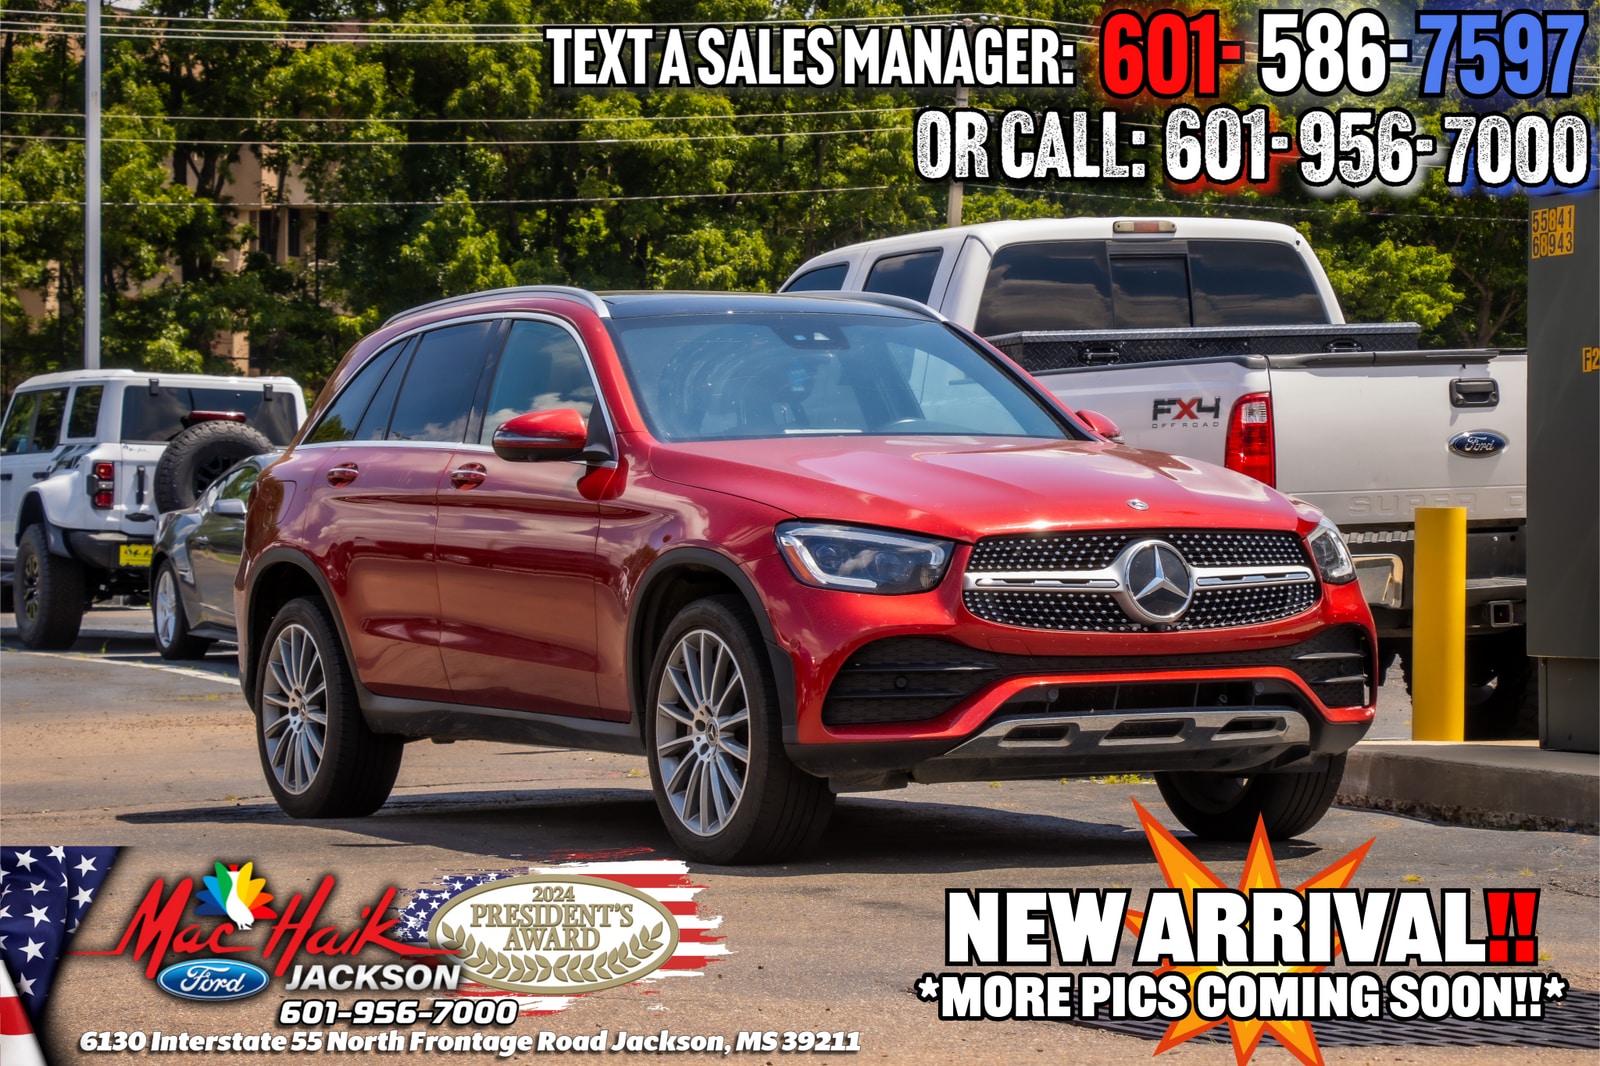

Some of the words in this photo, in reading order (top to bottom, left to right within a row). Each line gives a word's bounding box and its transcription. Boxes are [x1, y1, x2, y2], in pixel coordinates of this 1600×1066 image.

[1532, 207, 1573, 232] 55841
[1532, 231, 1573, 257] 68943
[1151, 397, 1221, 420] FX4
[1464, 436, 1496, 453] Ford
